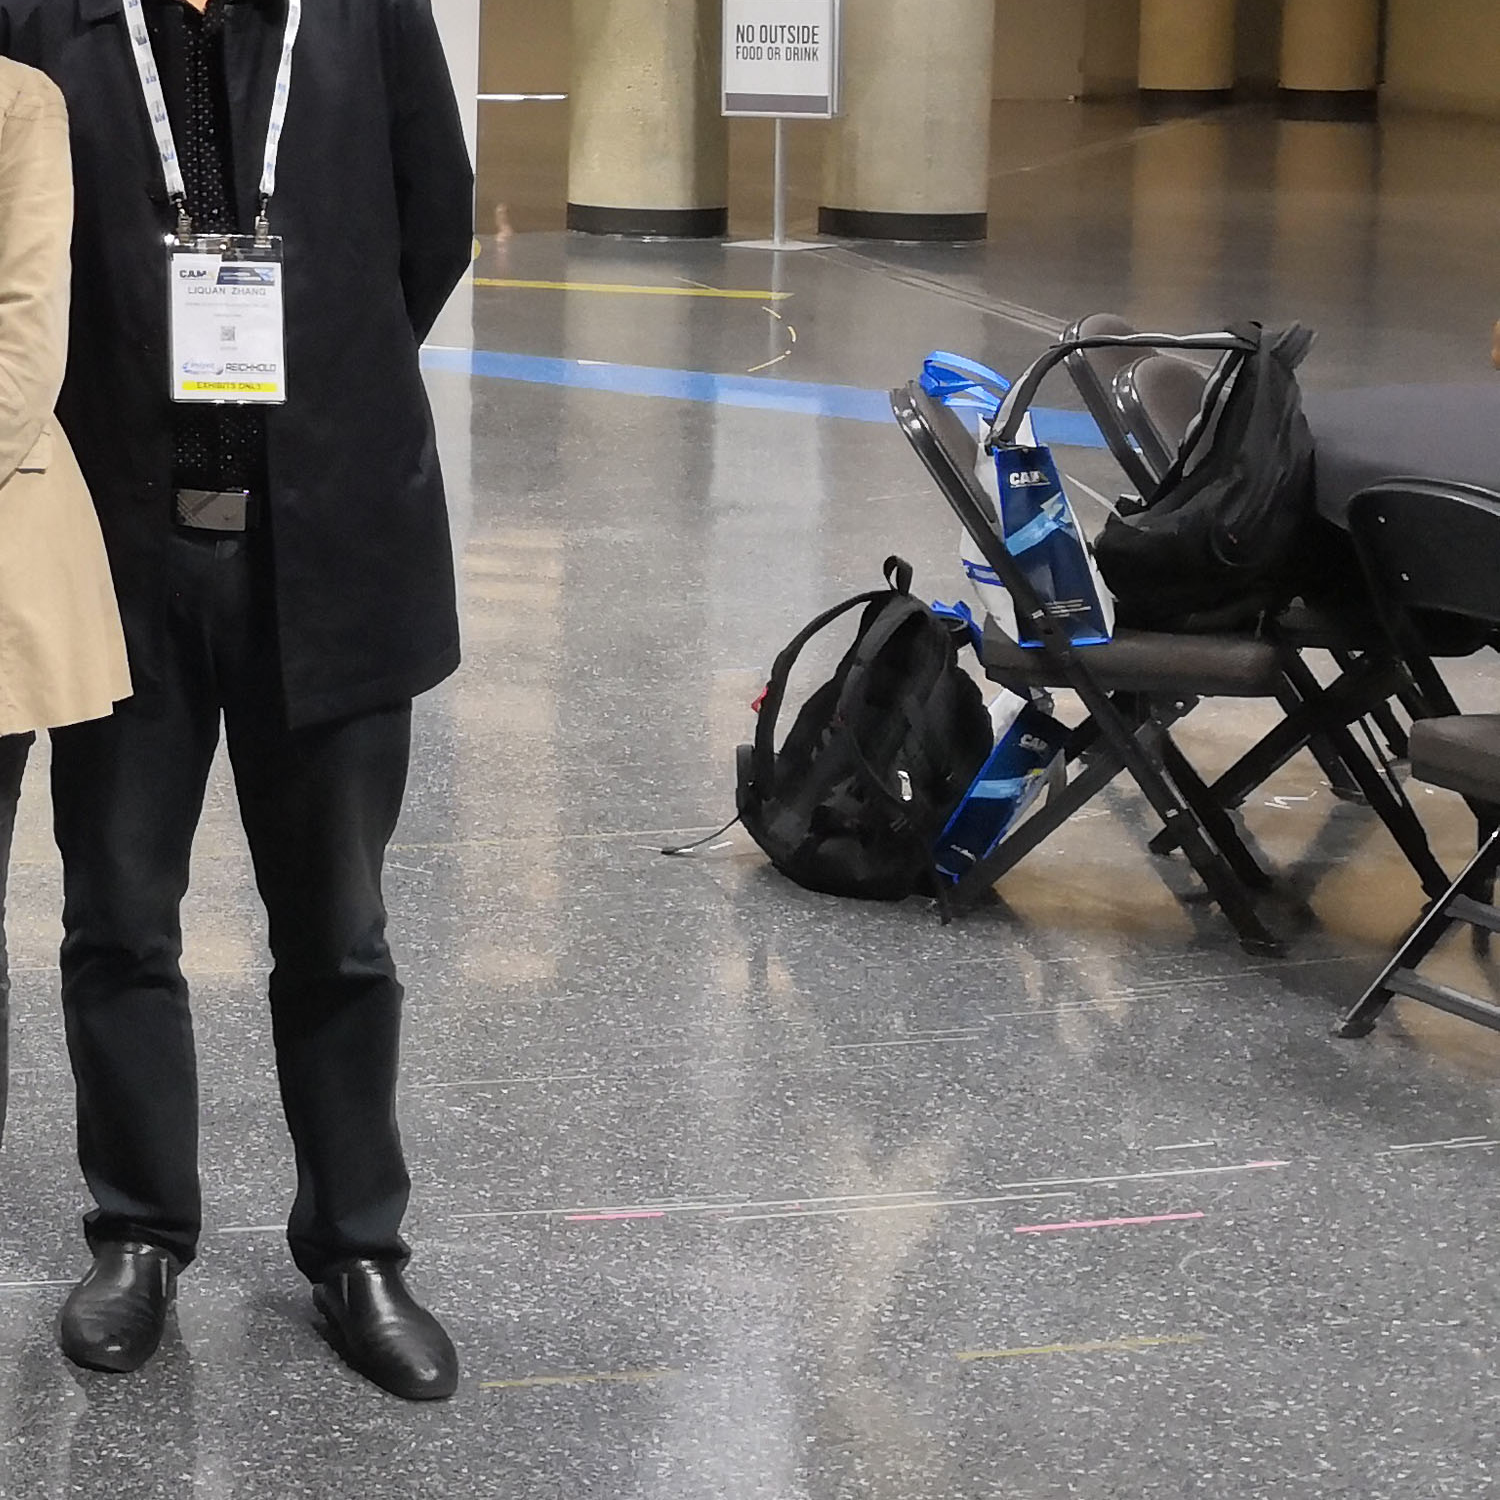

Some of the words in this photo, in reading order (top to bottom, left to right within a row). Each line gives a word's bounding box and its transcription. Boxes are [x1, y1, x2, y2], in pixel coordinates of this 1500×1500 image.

[736, 24, 754, 44] NO
[759, 25, 820, 45] OUTSIDE
[736, 46, 763, 61] FOOD
[767, 46, 782, 61] OR
[785, 46, 819, 62] DRINK
